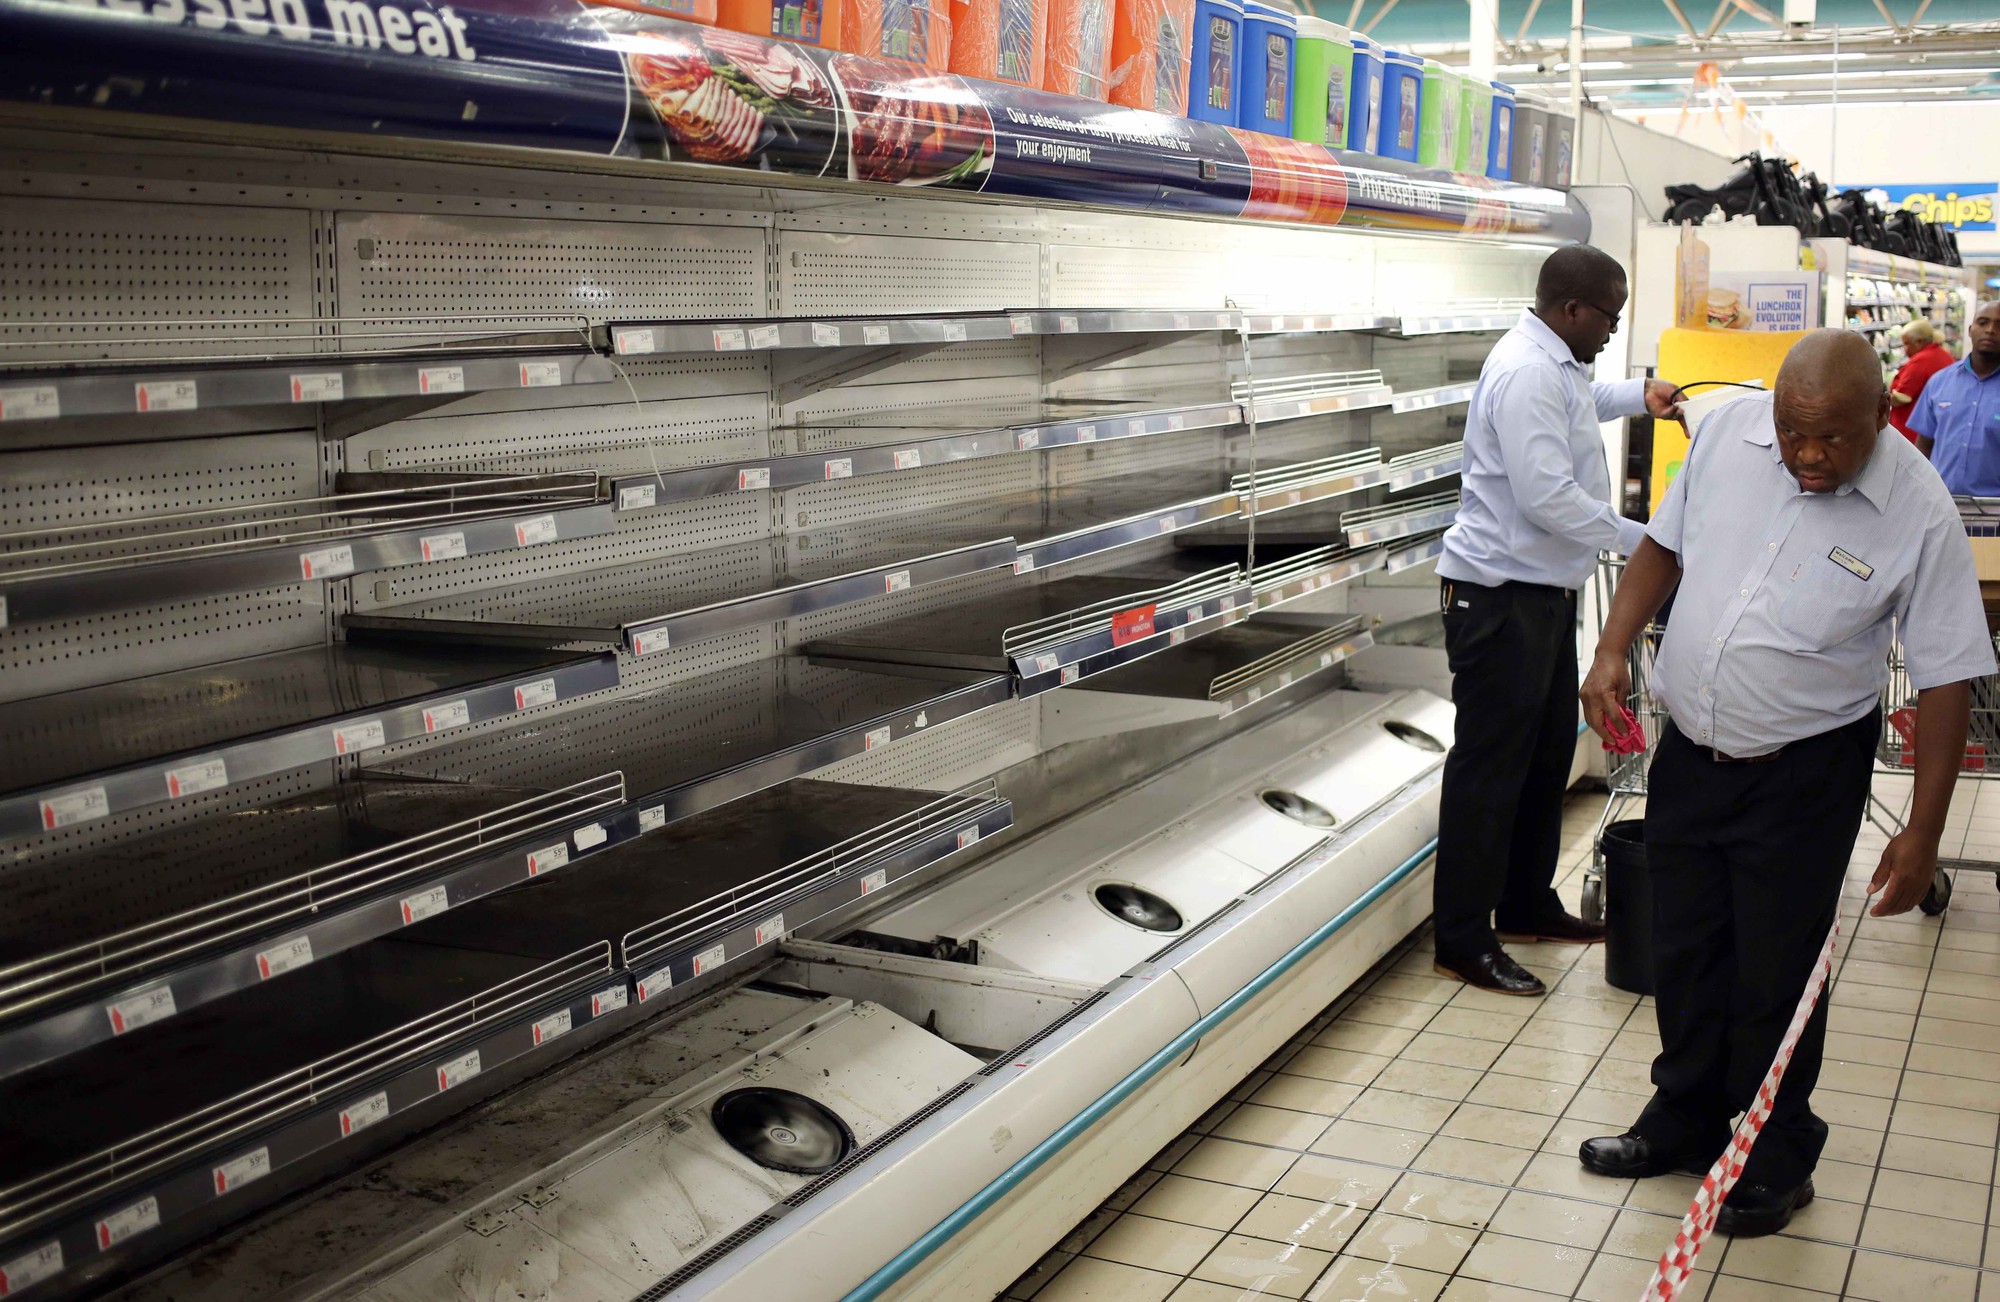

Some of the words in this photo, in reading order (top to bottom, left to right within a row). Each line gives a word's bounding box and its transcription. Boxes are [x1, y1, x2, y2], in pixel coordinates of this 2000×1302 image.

[324, 0, 477, 62] meat
[1006, 106, 1028, 125] Our
[1030, 112, 1076, 134] selection
[1078, 119, 1089, 135] of
[1115, 127, 1158, 147] processed
[1158, 134, 1179, 151] meat
[1178, 137, 1192, 153] for
[1016, 139, 1040, 158] your
[1041, 142, 1092, 164] enjoyment
[1357, 172, 1417, 208] Processed
[1417, 186, 1442, 212] meat
[1902, 192, 1993, 228] Chips
[1756, 301, 1801, 311] LUNCHBOX
[1786, 290, 1802, 299] THE
[1755, 312, 1801, 322] EVOLUTION
[1769, 324, 1778, 332] IS
[1780, 324, 1801, 332] HERE
